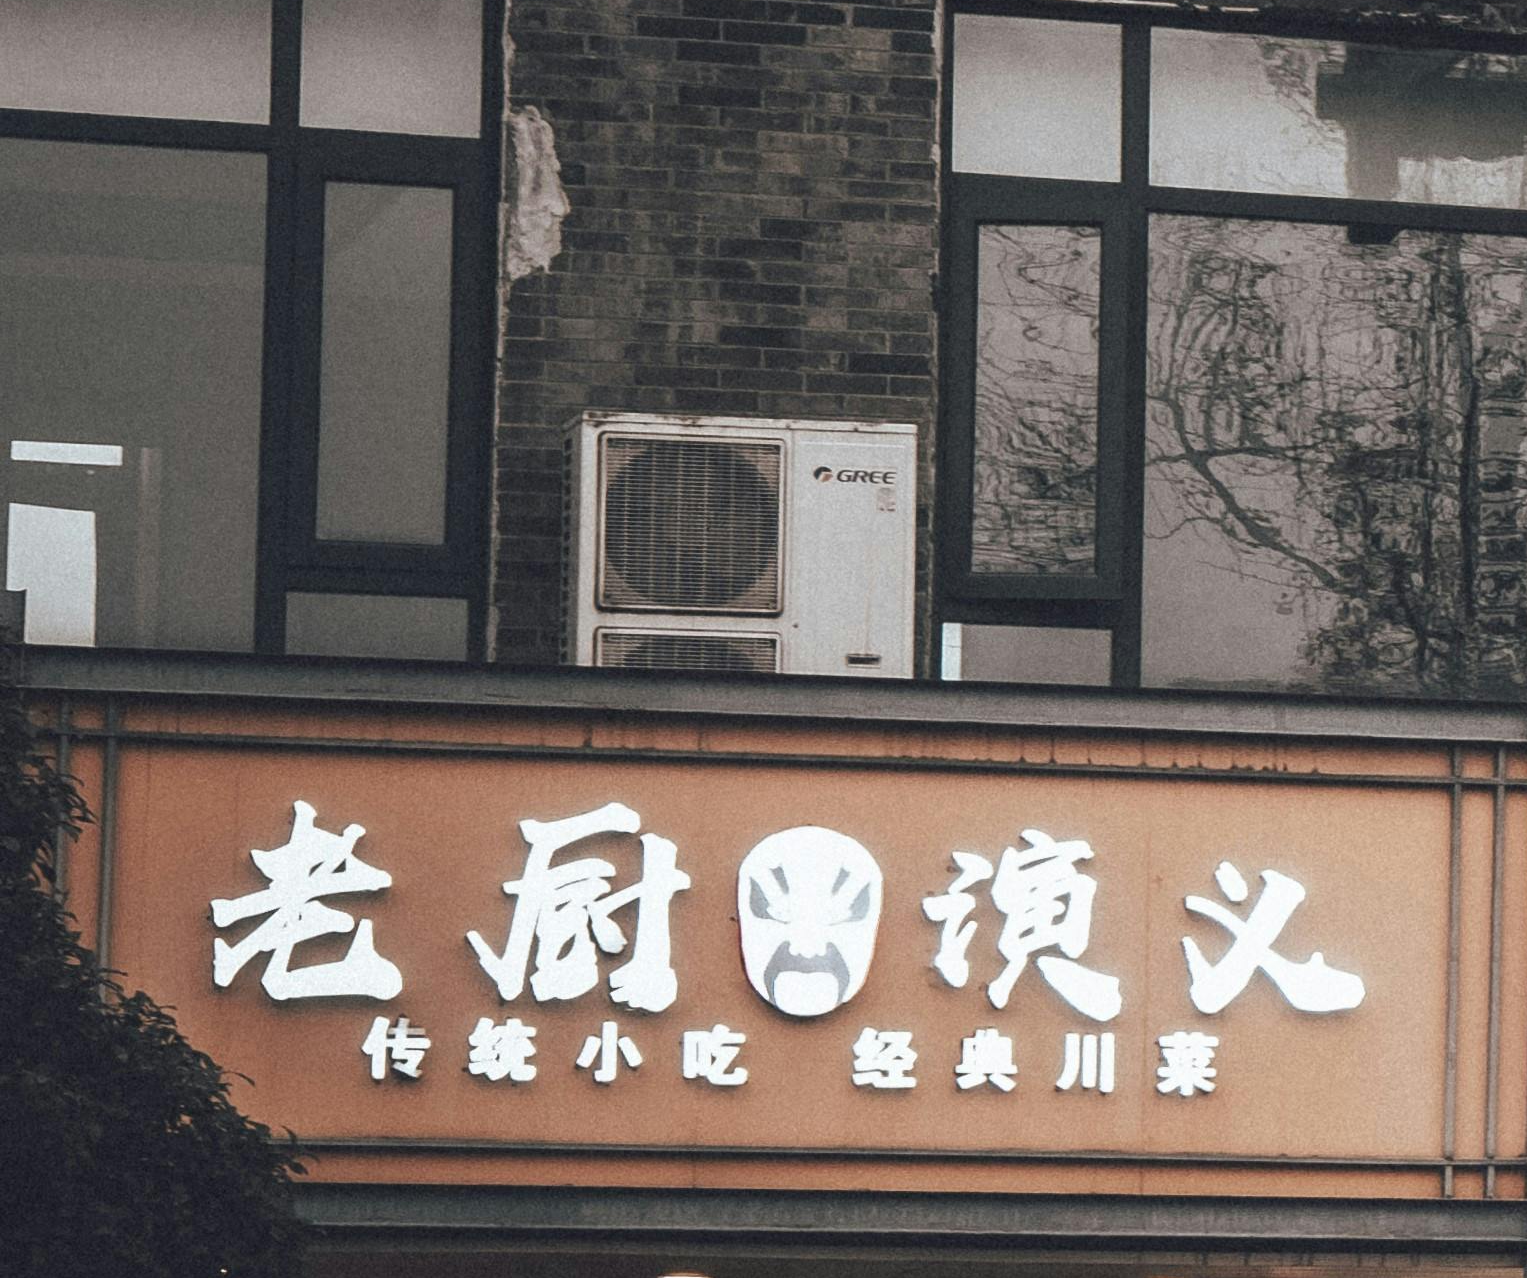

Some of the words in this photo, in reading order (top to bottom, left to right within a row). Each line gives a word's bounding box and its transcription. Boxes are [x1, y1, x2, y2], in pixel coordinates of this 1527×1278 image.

[837, 469, 897, 484] GREE
[210, 799, 1365, 1019] 老厨演义
[361, 1016, 748, 1086] 传统小吃
[851, 1025, 1224, 1098] 经典川菜
